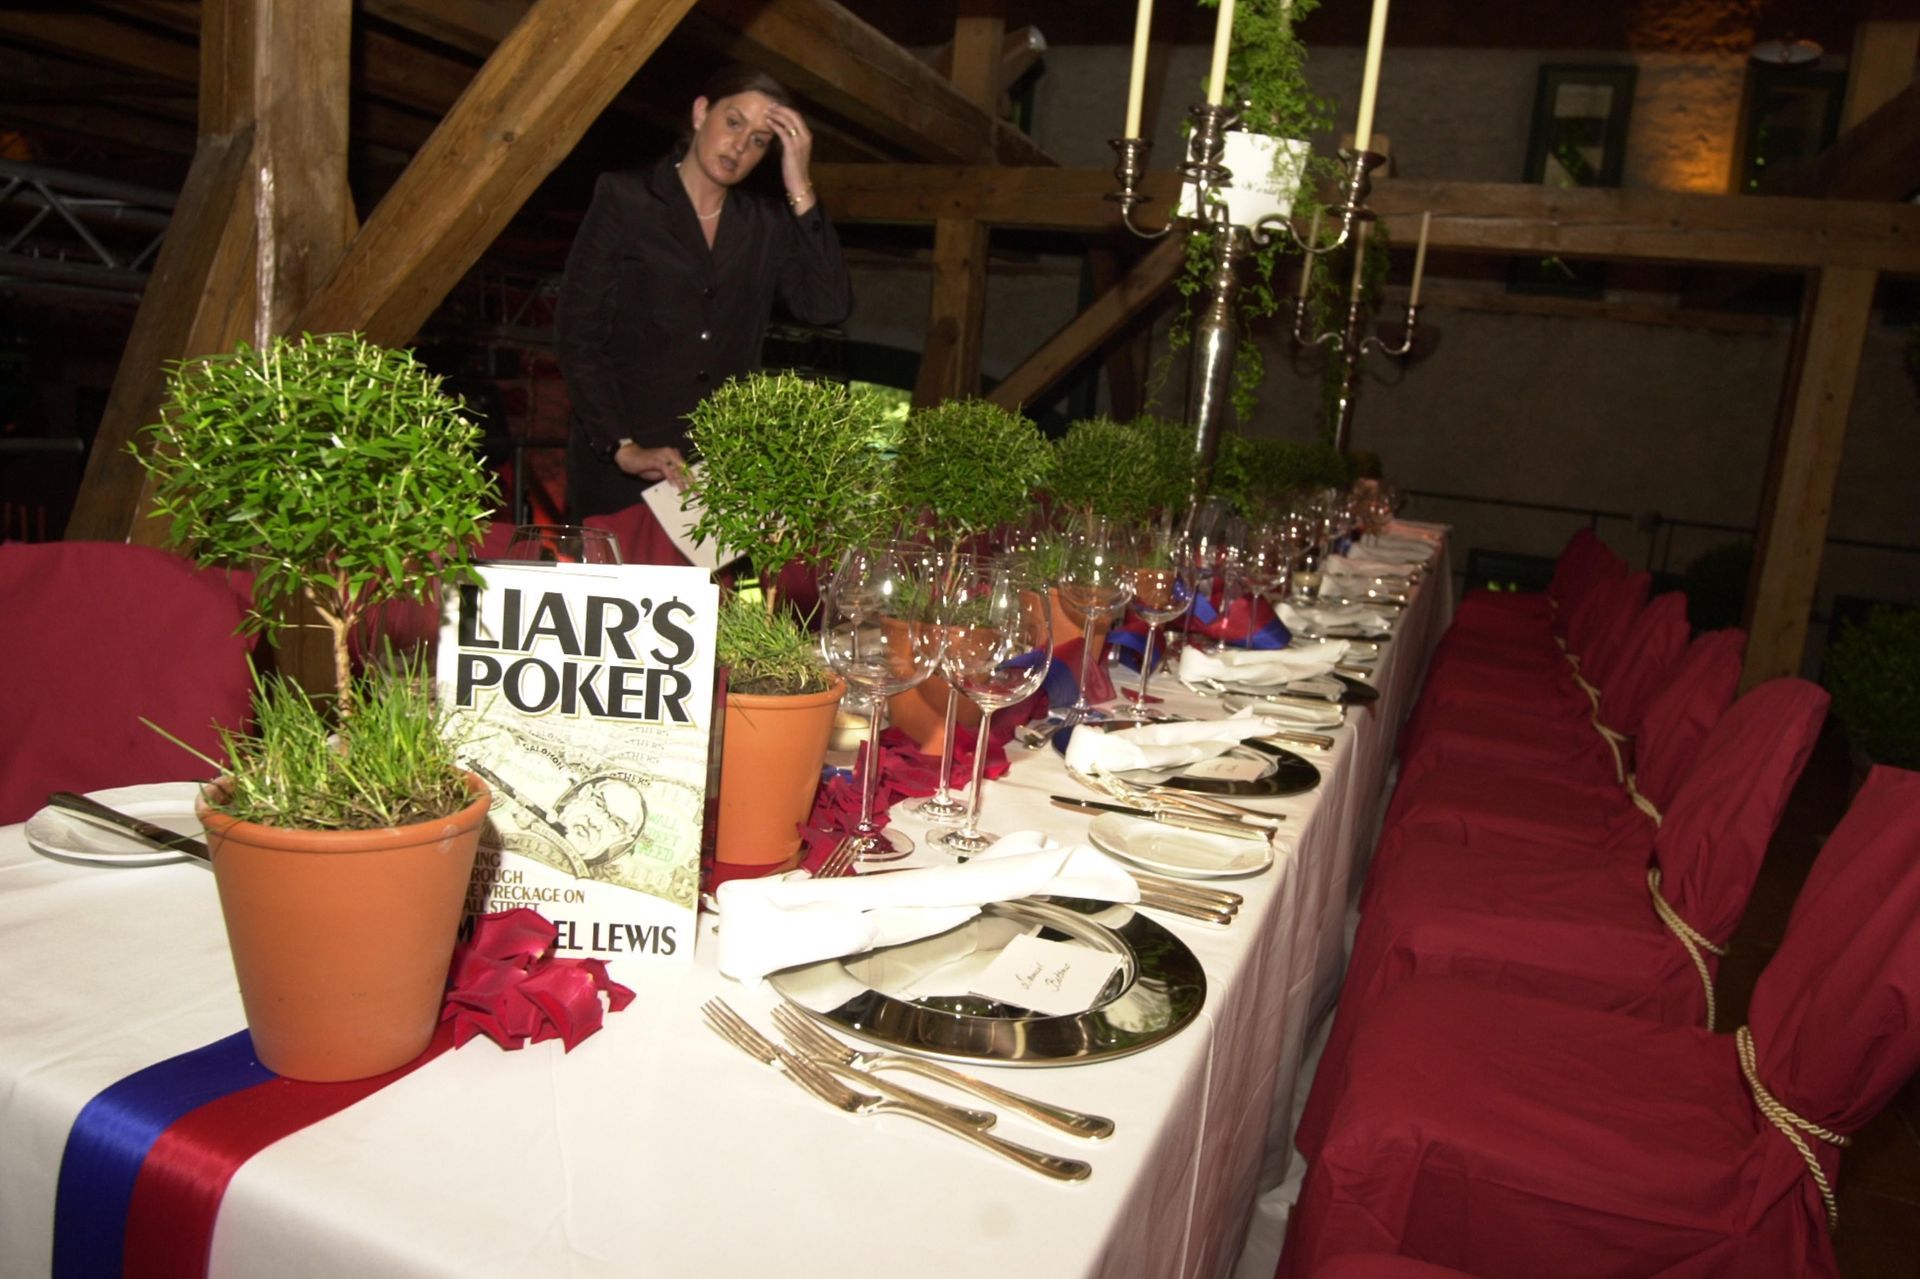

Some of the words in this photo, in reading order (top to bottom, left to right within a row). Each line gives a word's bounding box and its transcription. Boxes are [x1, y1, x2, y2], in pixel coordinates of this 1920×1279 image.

[456, 653, 692, 722] POKER
[474, 852, 501, 867] ING
[471, 867, 523, 885] ROUGH
[480, 884, 560, 903] WRECKAGE
[564, 889, 585, 904] ON
[463, 898, 486, 913] ALL
[592, 922, 677, 956] LEWIS
